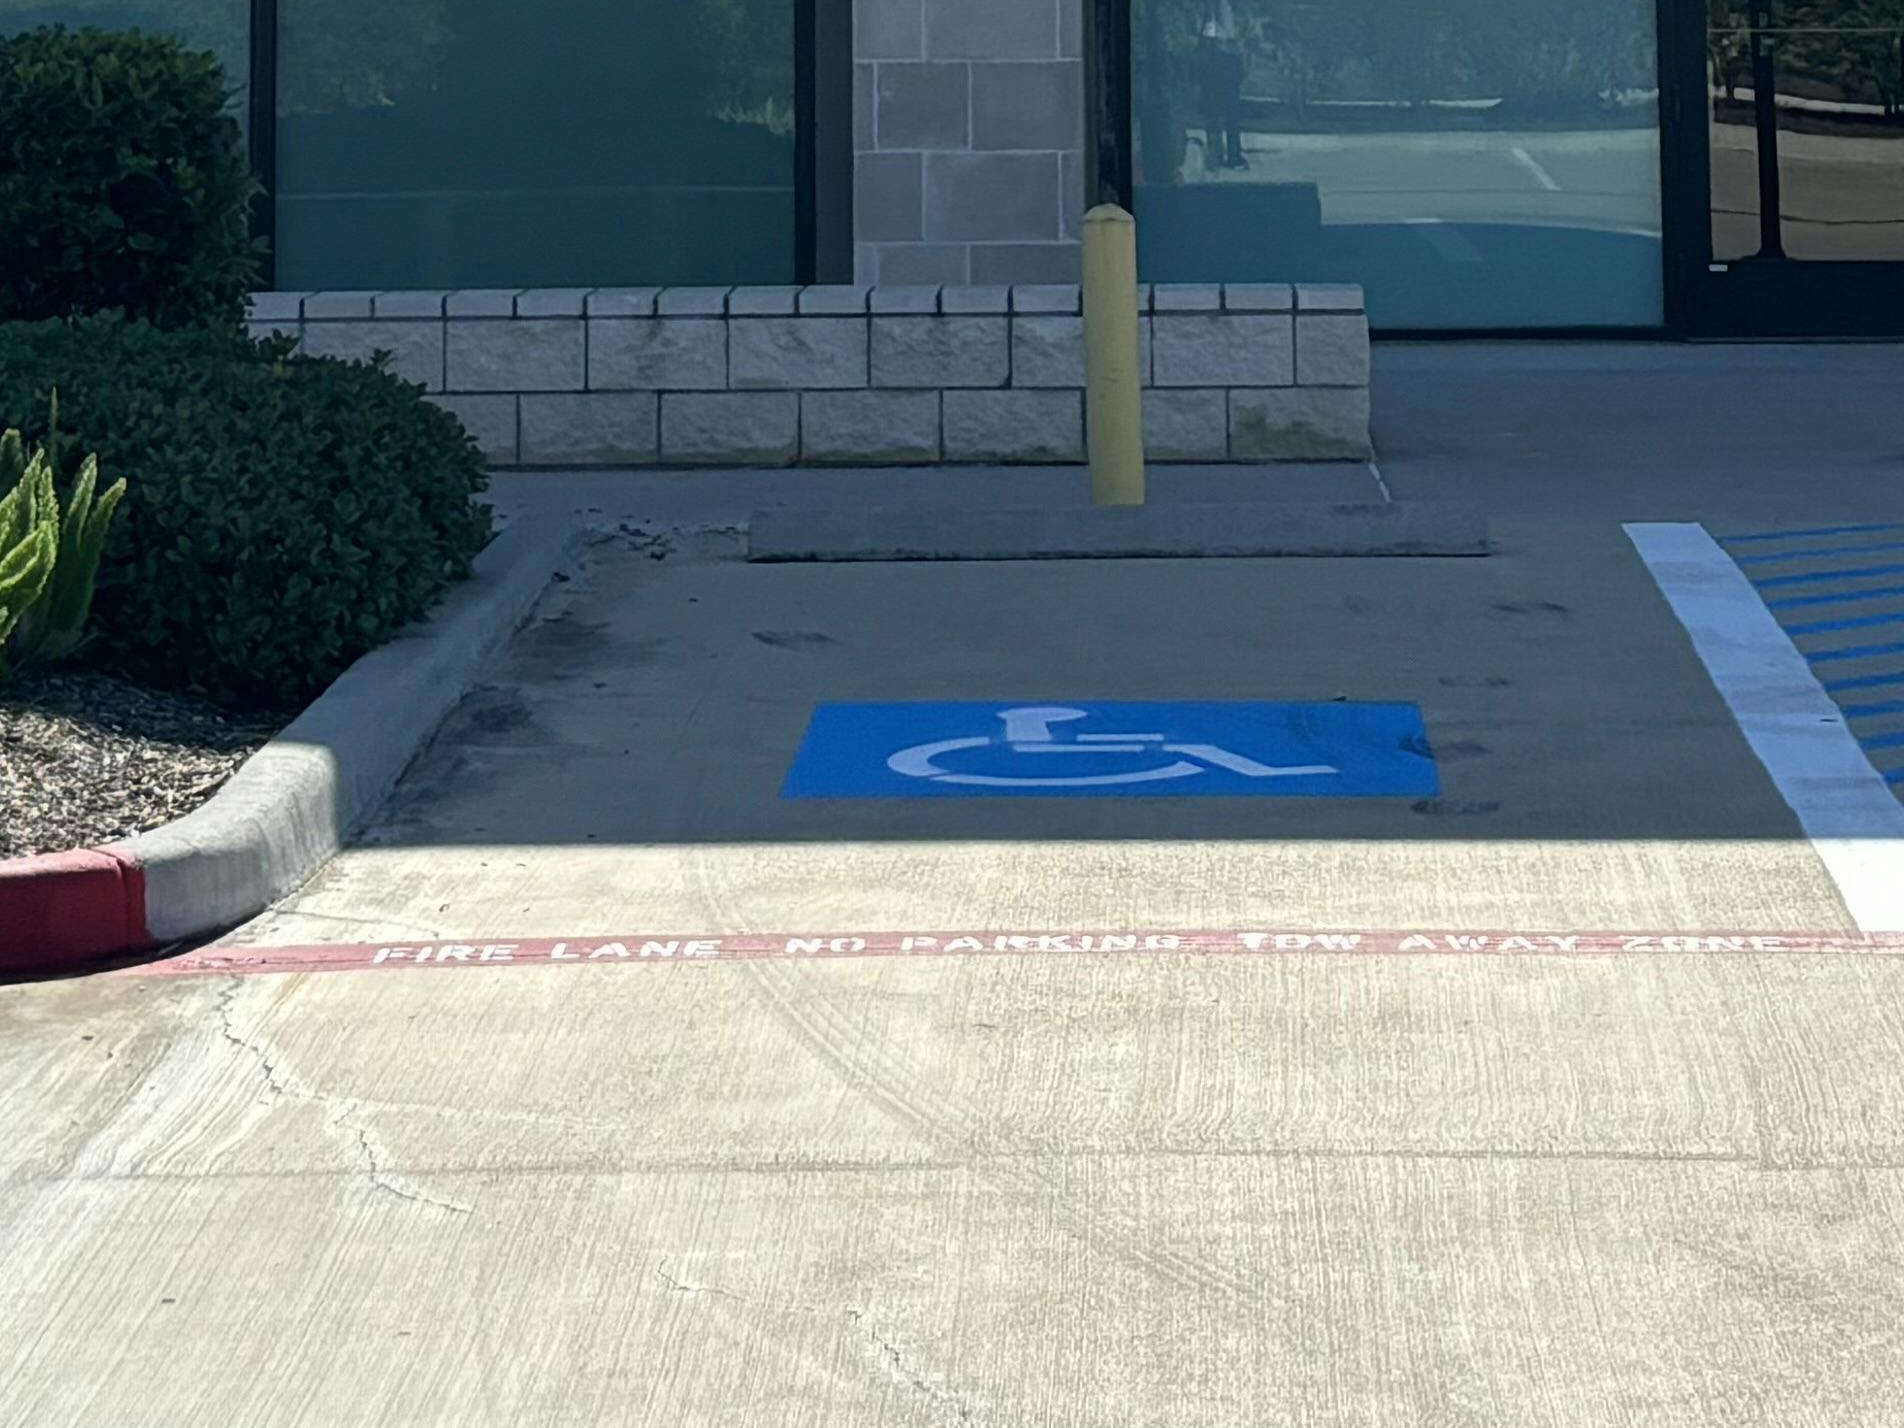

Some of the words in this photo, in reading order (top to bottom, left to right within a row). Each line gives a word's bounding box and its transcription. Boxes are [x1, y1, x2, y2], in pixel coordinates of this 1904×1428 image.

[371, 942, 521, 964] FIRE
[550, 938, 723, 960] LANE
[783, 937, 866, 954] NO
[1396, 933, 1580, 954] AWAY
